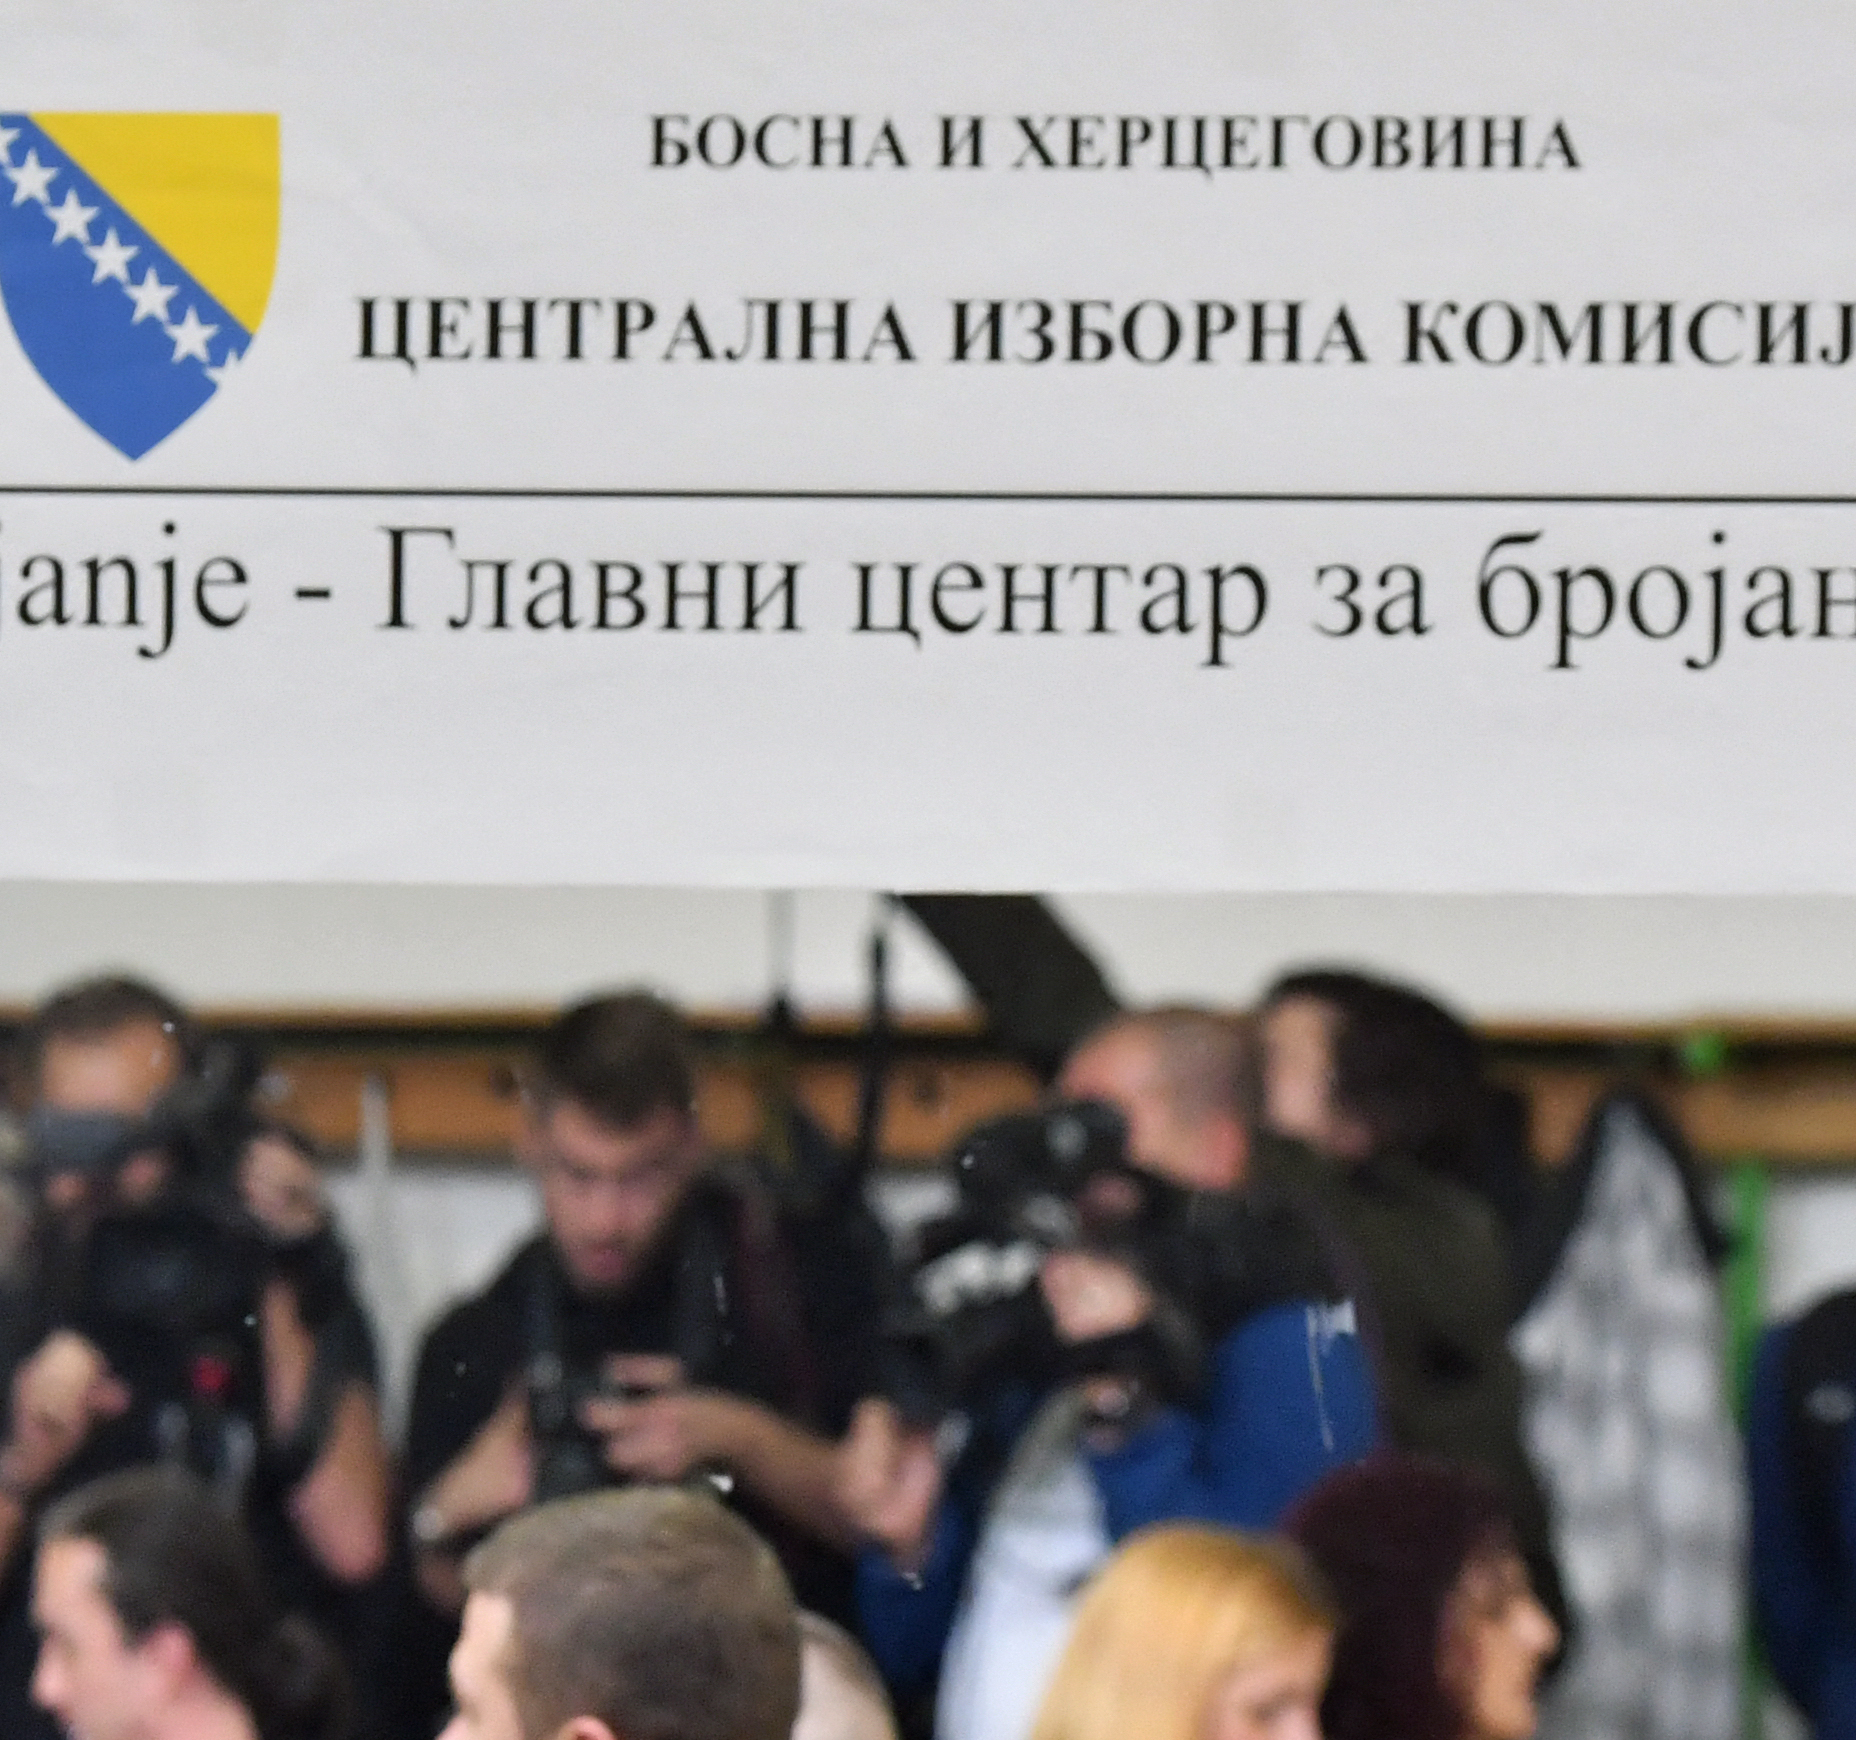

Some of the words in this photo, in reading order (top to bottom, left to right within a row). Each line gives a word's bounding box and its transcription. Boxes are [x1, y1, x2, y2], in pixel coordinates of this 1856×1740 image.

[650, 115, 911, 169] БОСНА
[937, 116, 985, 169] И
[1011, 116, 1583, 177] ХЕРЦЕГОВИНА
[355, 297, 919, 372] ЦЕНТРАЛНА
[949, 299, 1370, 365] ИЗБОРНА
[380, 524, 804, 634] Главни
[850, 559, 1270, 669] центар
[1314, 562, 1433, 639] за
